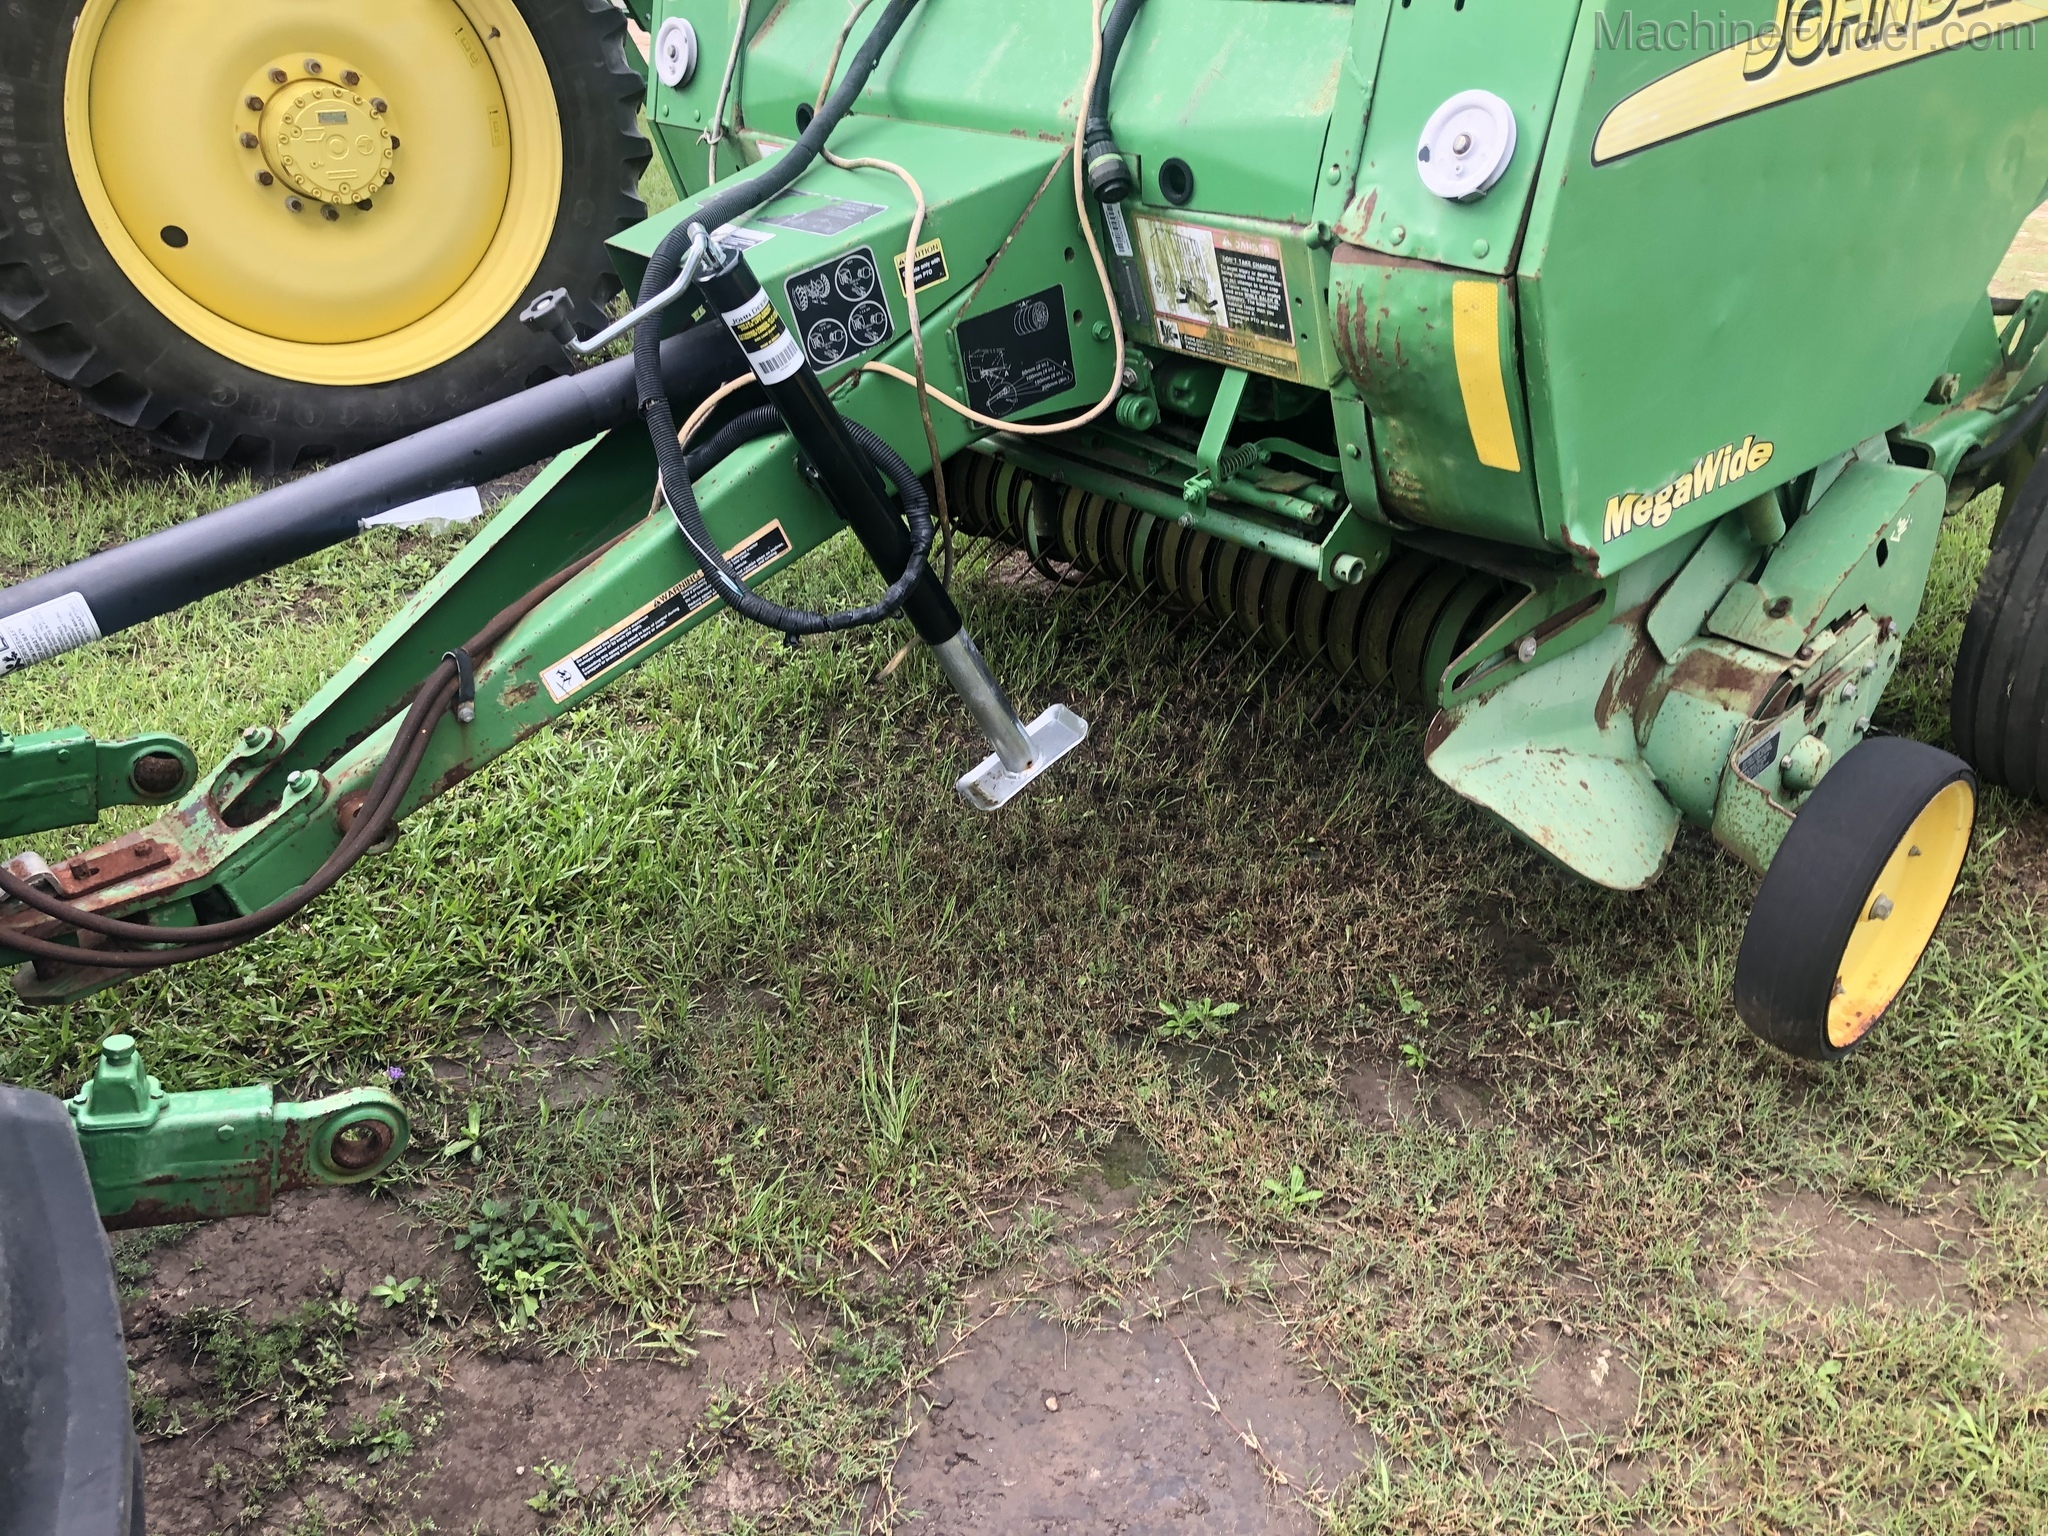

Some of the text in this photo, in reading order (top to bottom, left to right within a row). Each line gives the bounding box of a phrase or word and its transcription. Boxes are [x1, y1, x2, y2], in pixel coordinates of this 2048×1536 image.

[931, 257, 940, 265] with
[922, 268, 933, 277] PTO
[731, 311, 752, 325] JOHN
[1602, 434, 1775, 545] MegaWide
[659, 573, 700, 603] WARNING
